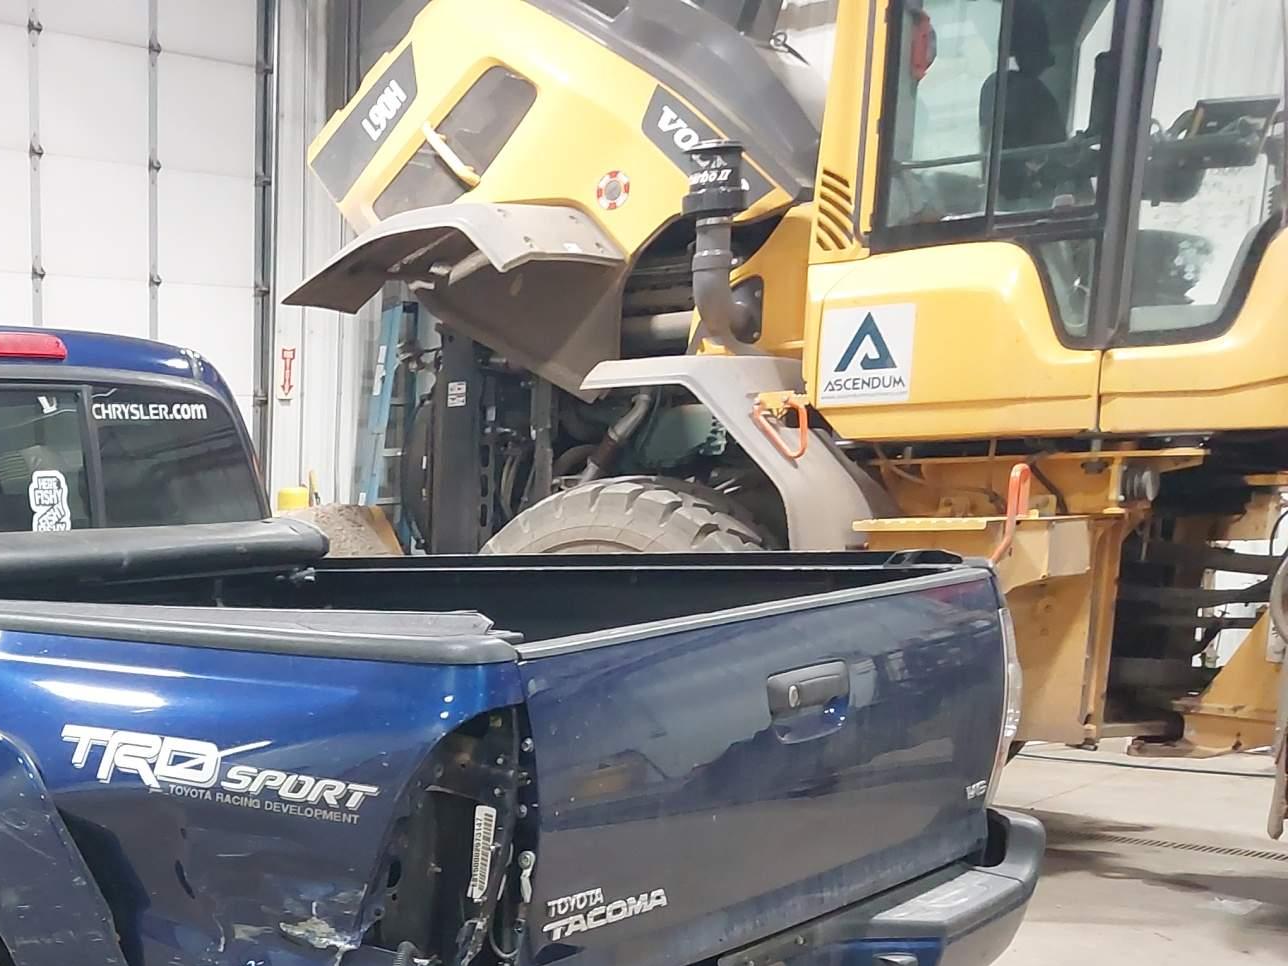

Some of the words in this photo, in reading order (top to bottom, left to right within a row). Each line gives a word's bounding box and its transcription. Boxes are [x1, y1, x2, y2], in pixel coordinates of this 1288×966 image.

[361, 79, 408, 142] L90H
[823, 375, 906, 393] ASCENDUM
[91, 402, 208, 420] CHRYSLER.com
[34, 488, 62, 505] FISHY
[61, 724, 224, 790] TRD
[220, 763, 380, 813] SPORT
[168, 783, 212, 801] TOYOTA
[215, 792, 261, 810] RACING
[264, 800, 362, 826] DEVELOPMENT
[542, 888, 668, 942] TACOMA
[547, 887, 604, 918] TOYOTA
